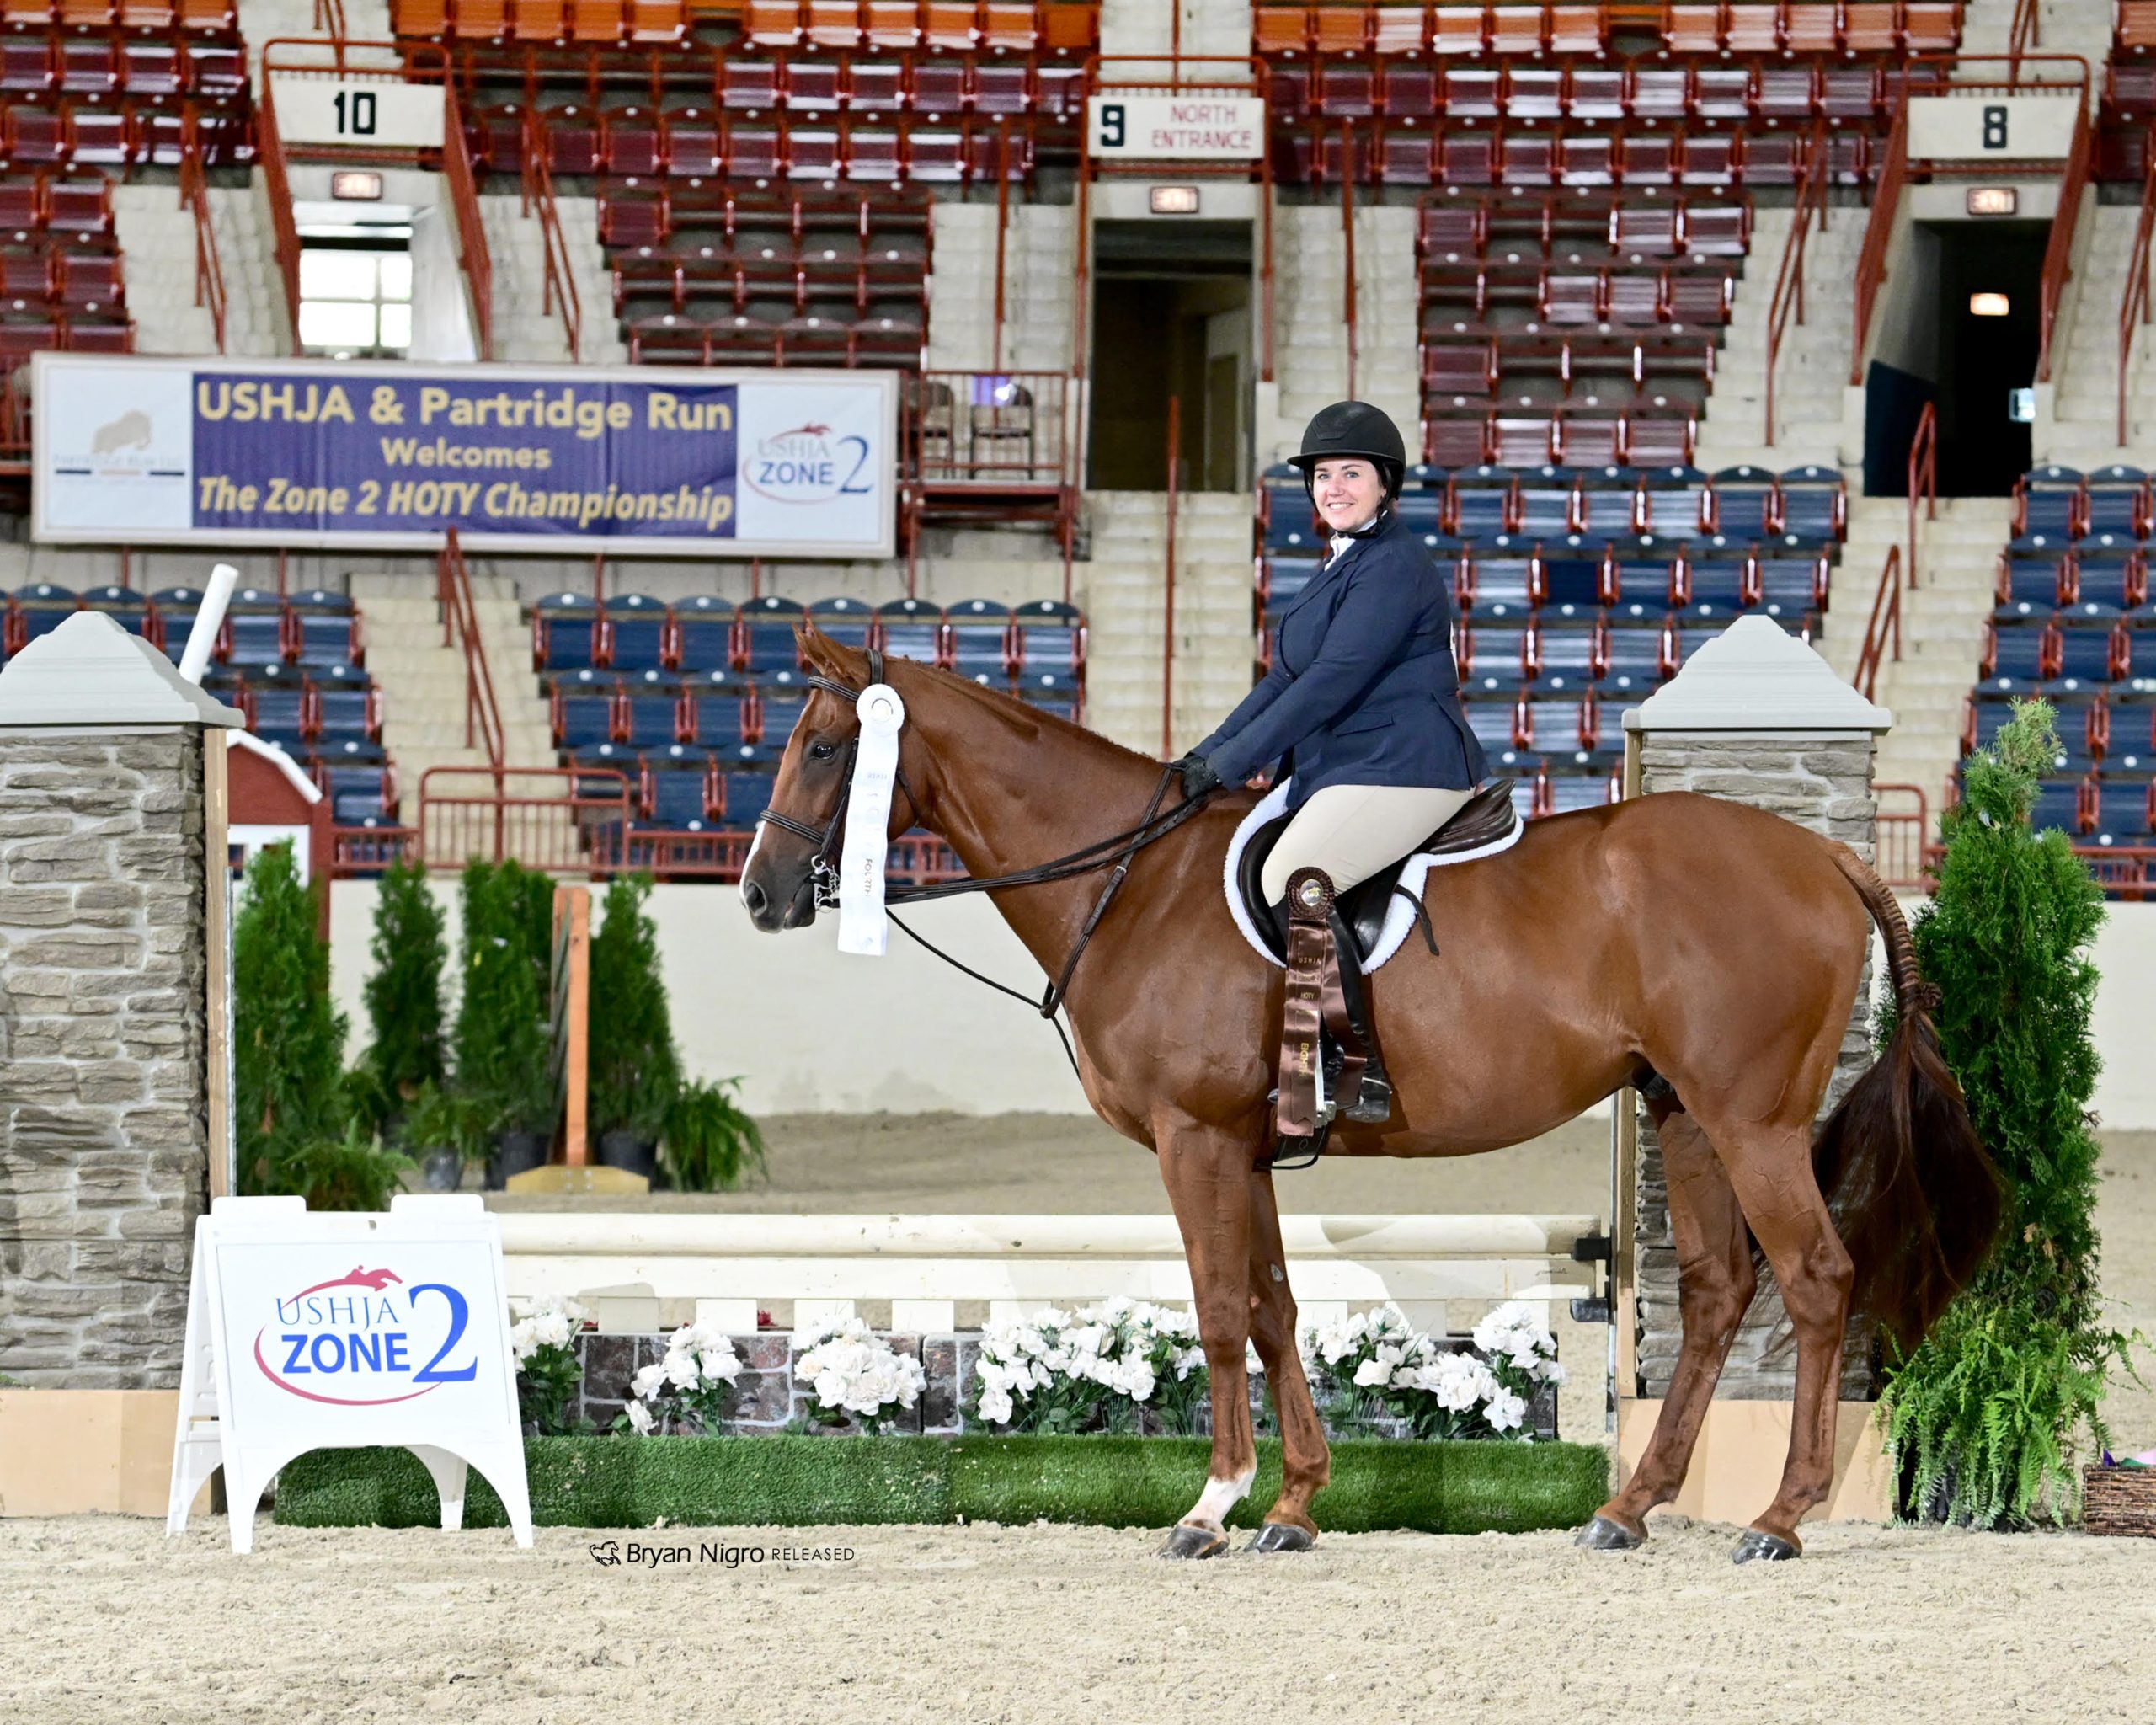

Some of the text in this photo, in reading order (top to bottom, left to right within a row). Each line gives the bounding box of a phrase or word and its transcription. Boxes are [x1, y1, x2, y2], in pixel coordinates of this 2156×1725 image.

[334, 91, 376, 135] 10
[1101, 104, 1125, 147] 9
[1171, 104, 1236, 124] NORTH
[1983, 106, 2008, 149] 8
[1152, 130, 1251, 149] ENTRANCE
[197, 381, 733, 440] USHJA & Partridge Run
[380, 436, 552, 469] Welcomes
[757, 438, 831, 460] USHJA
[758, 435, 874, 494] ZONE 2
[198, 475, 733, 532] The Zone 2 HOTY Championship
[275, 1295, 400, 1332] USHJA
[281, 1283, 478, 1383] ZONE 2
